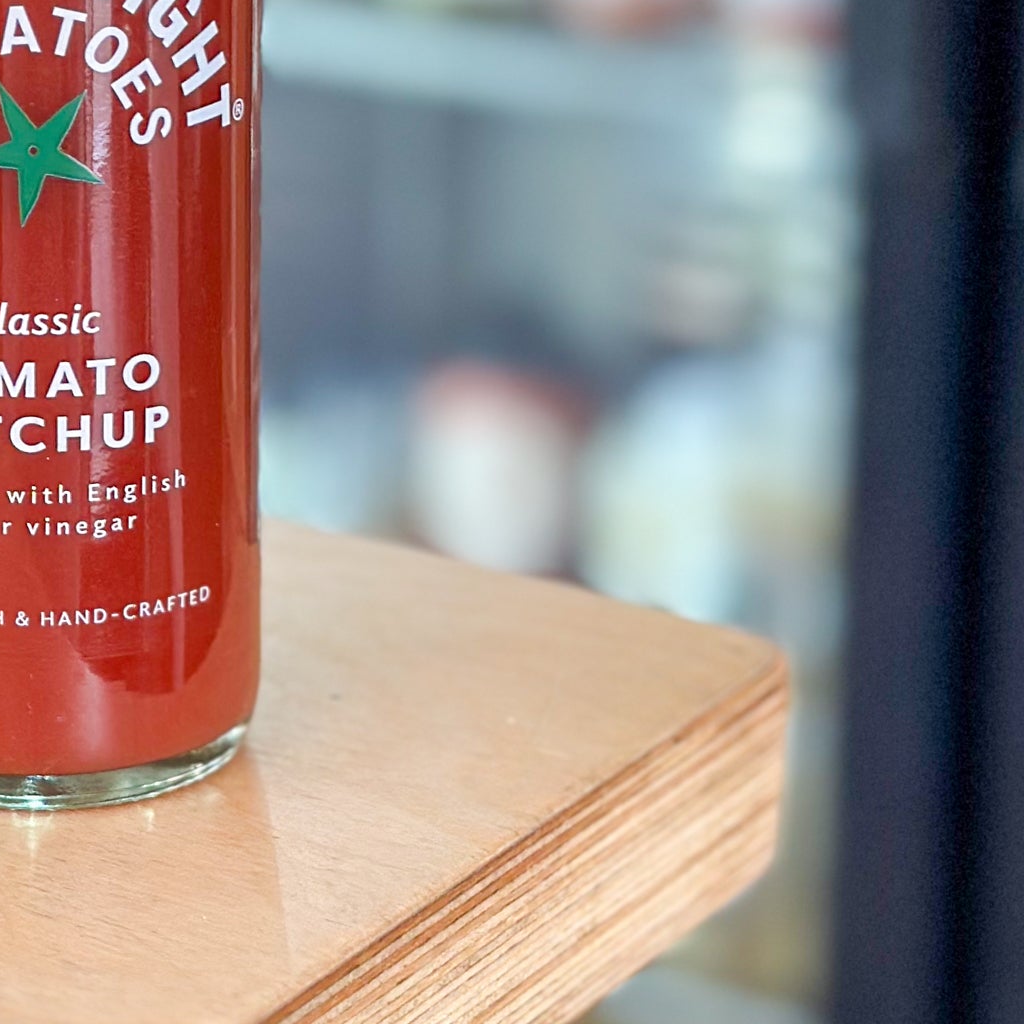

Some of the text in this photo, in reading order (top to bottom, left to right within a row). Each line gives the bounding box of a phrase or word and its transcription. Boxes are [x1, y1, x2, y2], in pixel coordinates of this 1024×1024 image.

[6, 484, 72, 505] with
[87, 468, 186, 504] English
[26, 514, 138, 539] vinegar
[14, 610, 30, 627] &
[39, 585, 211, 627] HAND-CRAFTED
